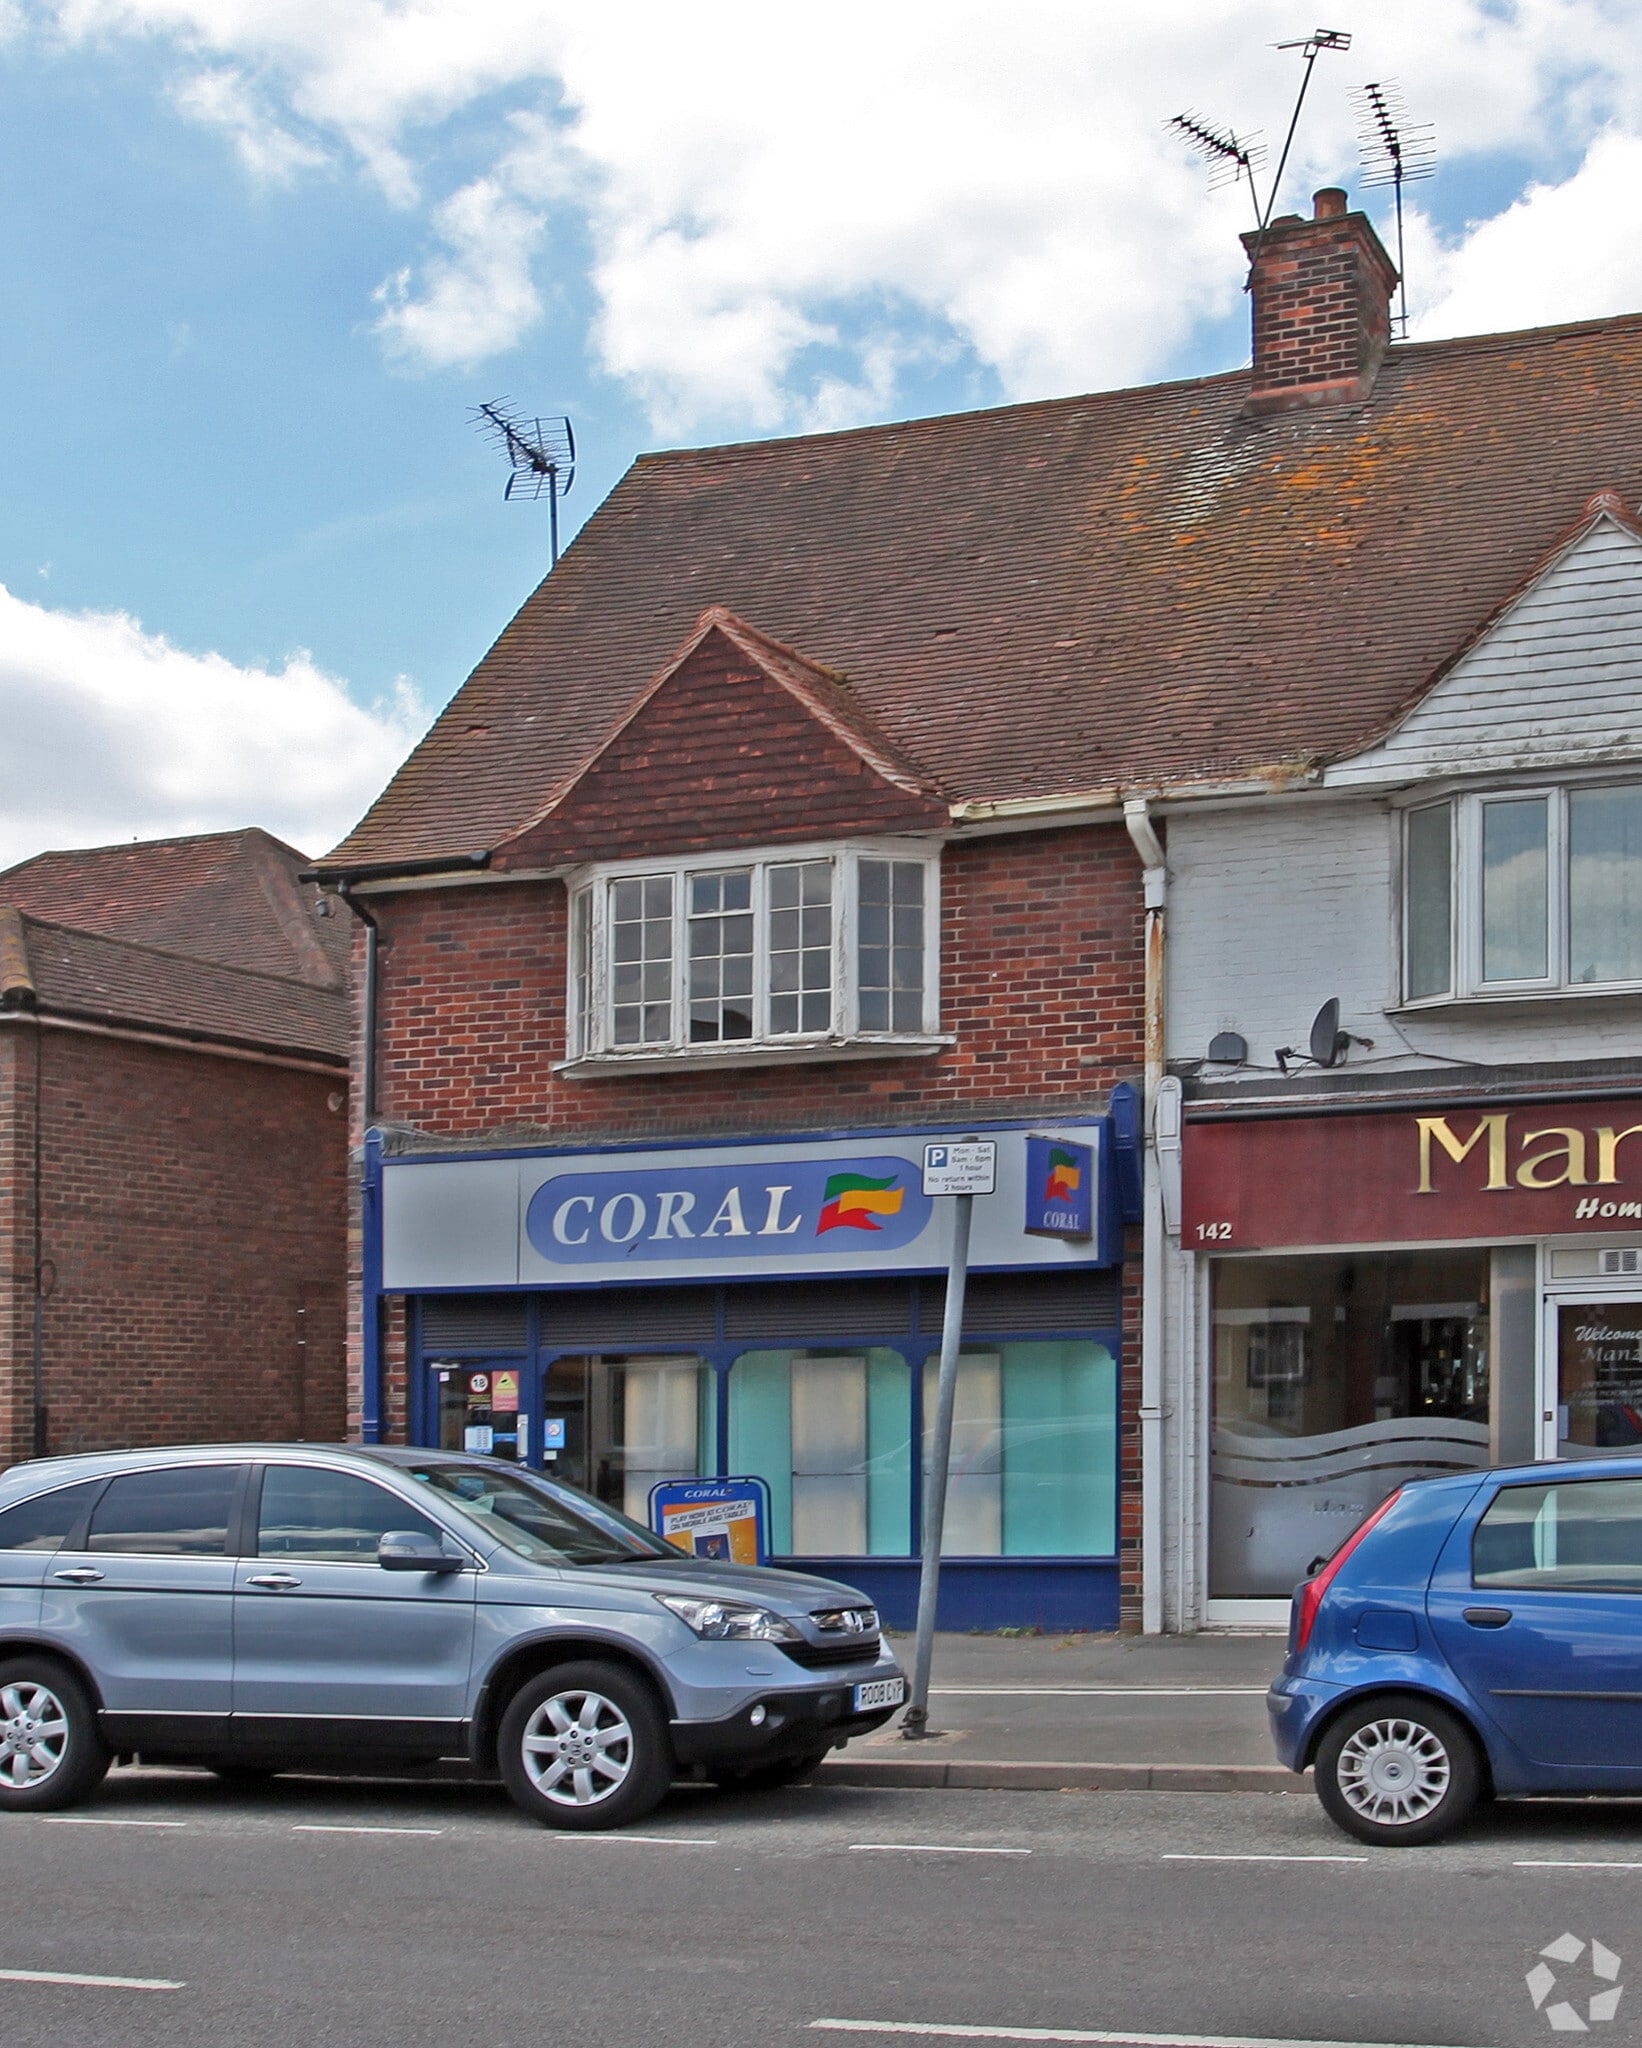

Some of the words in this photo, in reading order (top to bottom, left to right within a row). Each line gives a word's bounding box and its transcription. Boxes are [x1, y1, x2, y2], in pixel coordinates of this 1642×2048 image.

[931, 1149, 944, 1166] P
[977, 1146, 992, 1154] Sat
[941, 1175, 966, 1183] return
[552, 1185, 802, 1245] CORAL
[1043, 1210, 1081, 1230] CORAL
[1195, 1222, 1233, 1240] 142
[473, 1378, 487, 1388] 18
[684, 1488, 728, 1499] CORAL
[670, 1514, 687, 1524] PLAY
[688, 1511, 706, 1520] NOW
[716, 1501, 748, 1514] CORAL
[670, 1523, 681, 1531] ON
[681, 1518, 707, 1529] MOBILE
[707, 1514, 723, 1523] AND
[723, 1509, 748, 1520] TABLET
